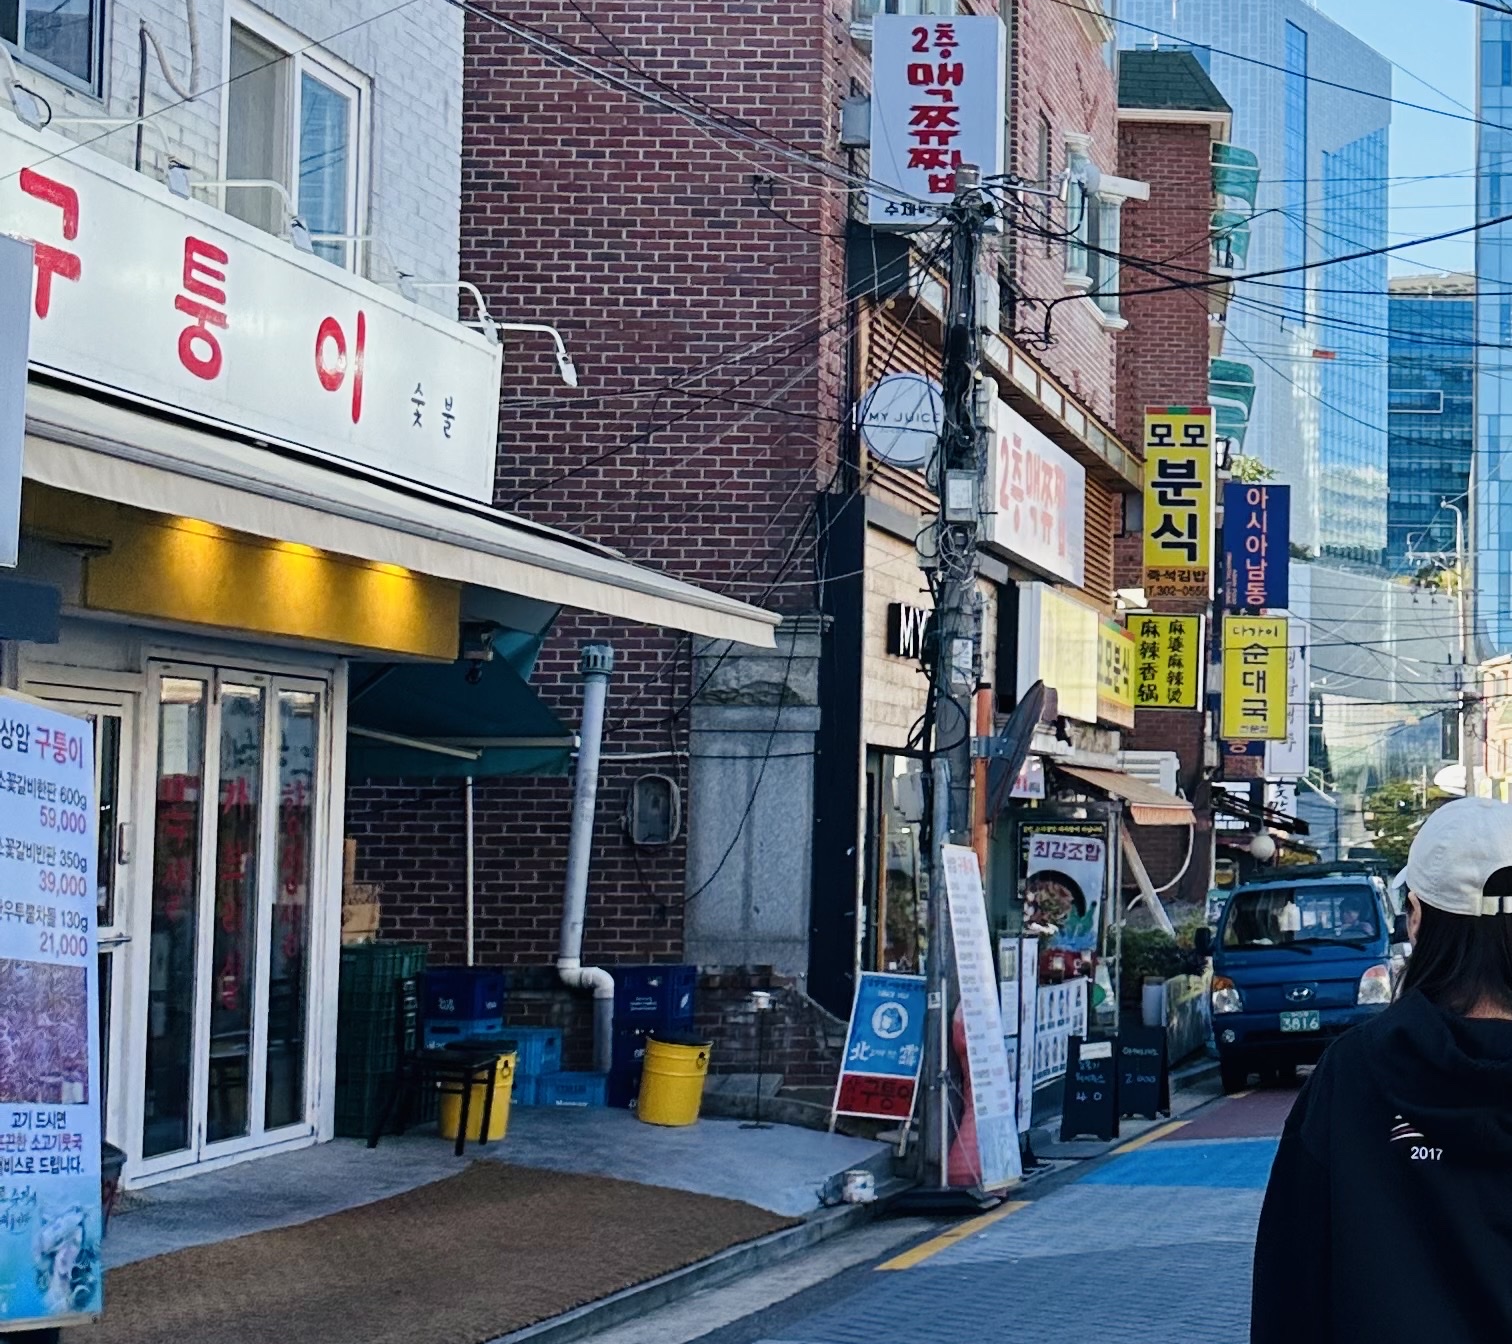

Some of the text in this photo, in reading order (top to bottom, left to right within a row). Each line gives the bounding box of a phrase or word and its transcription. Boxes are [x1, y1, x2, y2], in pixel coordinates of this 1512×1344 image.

[912, 23, 960, 59] 2층
[869, 412, 941, 423] MY JUICE
[1147, 424, 1208, 447] 모모
[1150, 459, 1202, 562] 분식
[900, 603, 927, 659] MY
[1241, 642, 1269, 722] 순대국
[60, 787, 87, 812] 600g
[40, 805, 87, 835] 59,000
[60, 849, 88, 873] 350g
[1033, 840, 1101, 862] 최강조합
[38, 869, 87, 898] 39,000
[61, 910, 88, 934] 130g
[40, 931, 88, 957] 21,000
[12, 1111, 67, 1130] 고기 드시면
[1410, 1146, 1443, 1161] 2017
